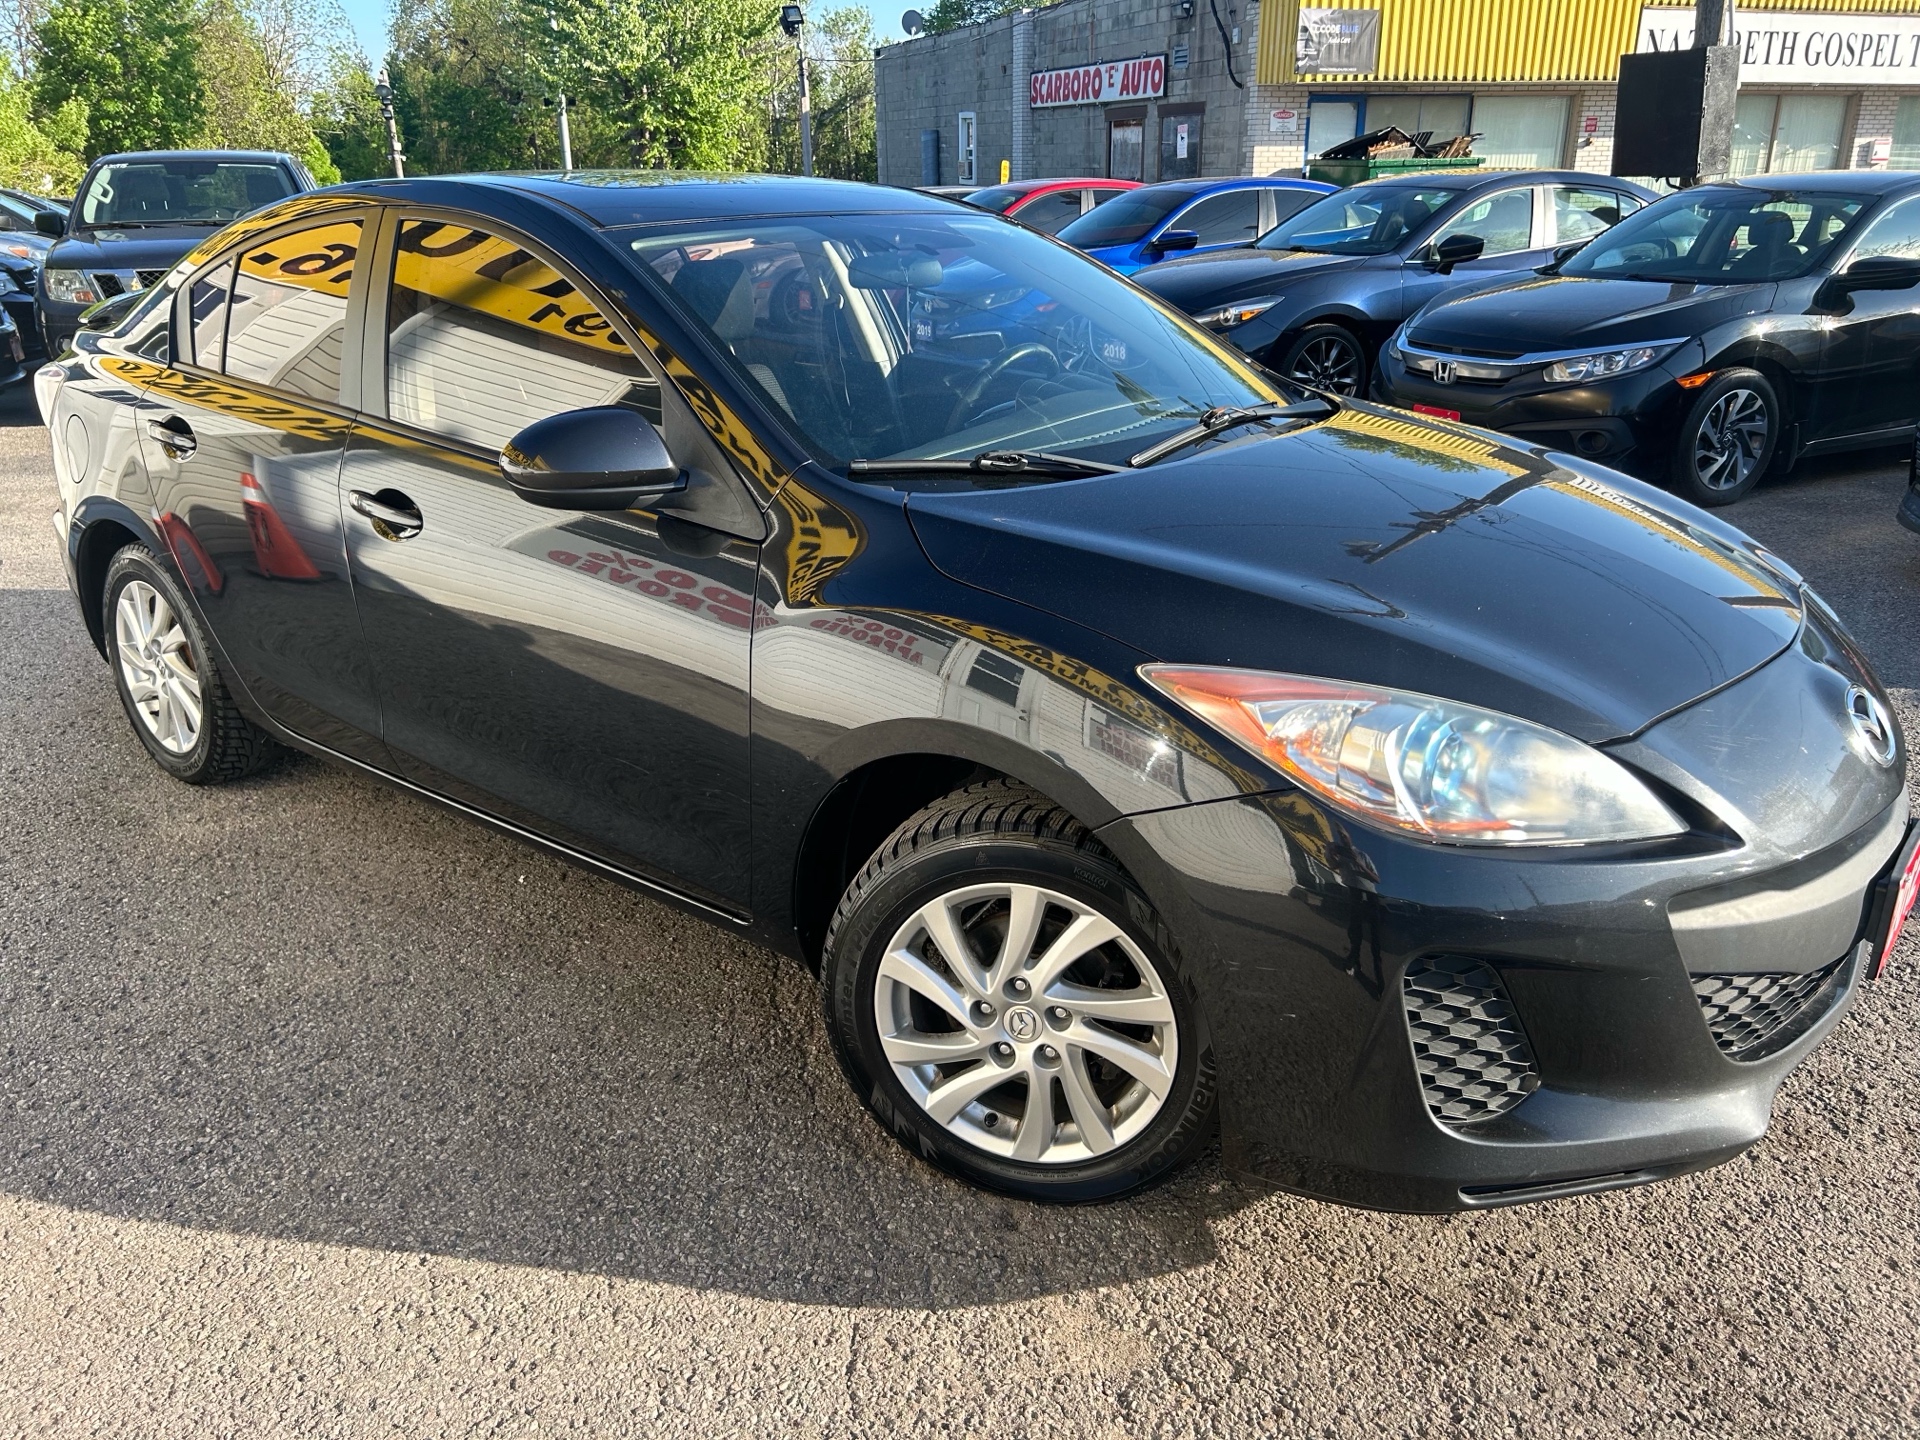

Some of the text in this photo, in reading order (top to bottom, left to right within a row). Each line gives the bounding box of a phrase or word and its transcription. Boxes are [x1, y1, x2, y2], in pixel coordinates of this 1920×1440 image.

[1645, 28, 1800, 65] NAETH
[1804, 31, 1904, 67] GOSPEL
[1031, 67, 1103, 105] SCARBORO
[1119, 58, 1163, 96] AUTO
[916, 324, 932, 337] 2019
[1103, 343, 1126, 360] 2018
